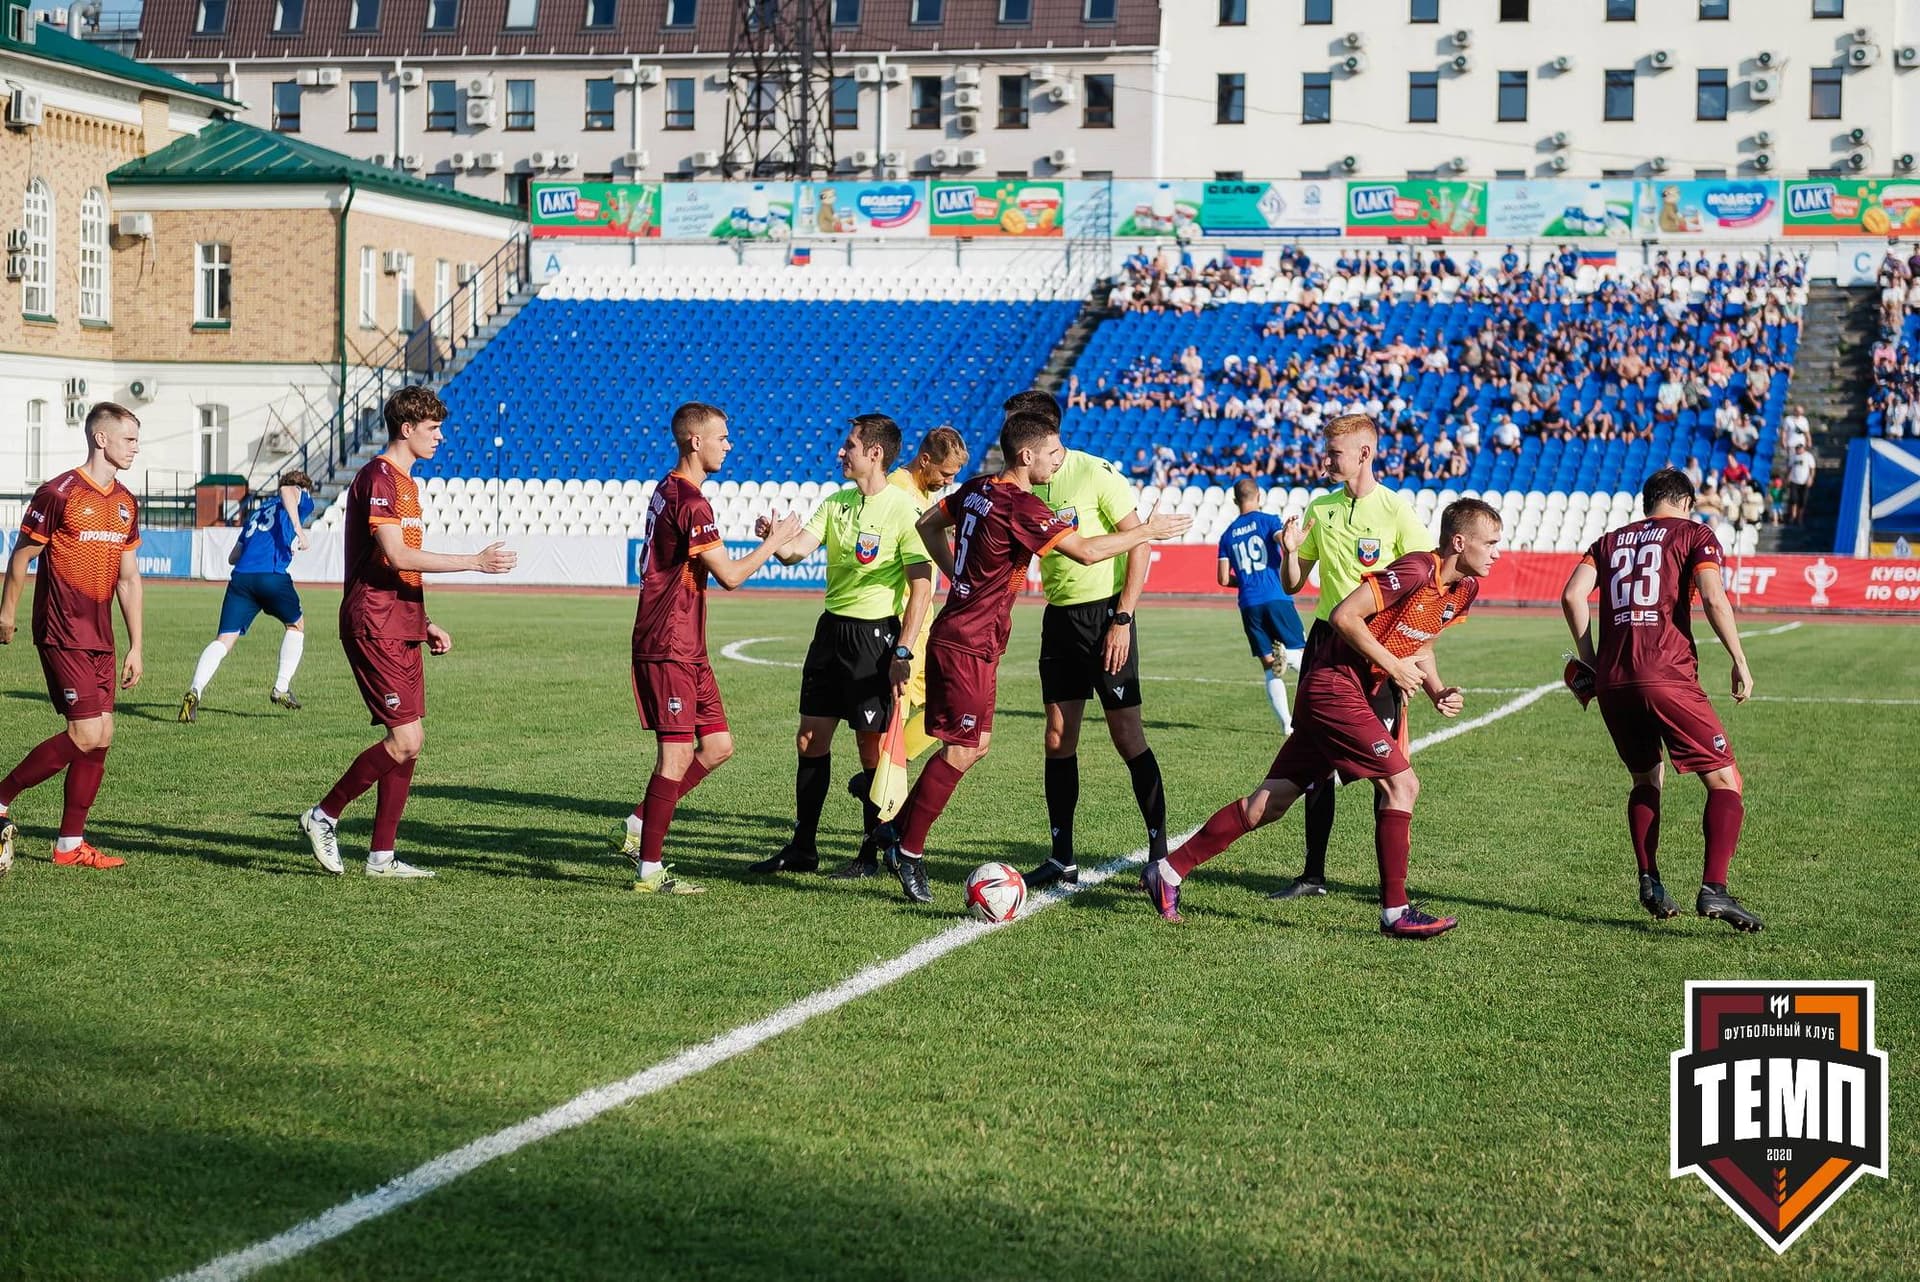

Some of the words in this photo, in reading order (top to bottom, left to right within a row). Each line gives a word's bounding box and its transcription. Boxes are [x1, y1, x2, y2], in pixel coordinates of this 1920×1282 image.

[542, 191, 578, 214] ЛАКТ
[937, 190, 975, 213] ЛАКТ
[1357, 188, 1395, 212] ЛАКТ
[1793, 188, 1833, 211] ЛАКТ
[954, 513, 977, 576] 5
[1610, 544, 1662, 610] 23
[1865, 585, 1891, 601] ПО
[1614, 610, 1659, 626] SEUS
